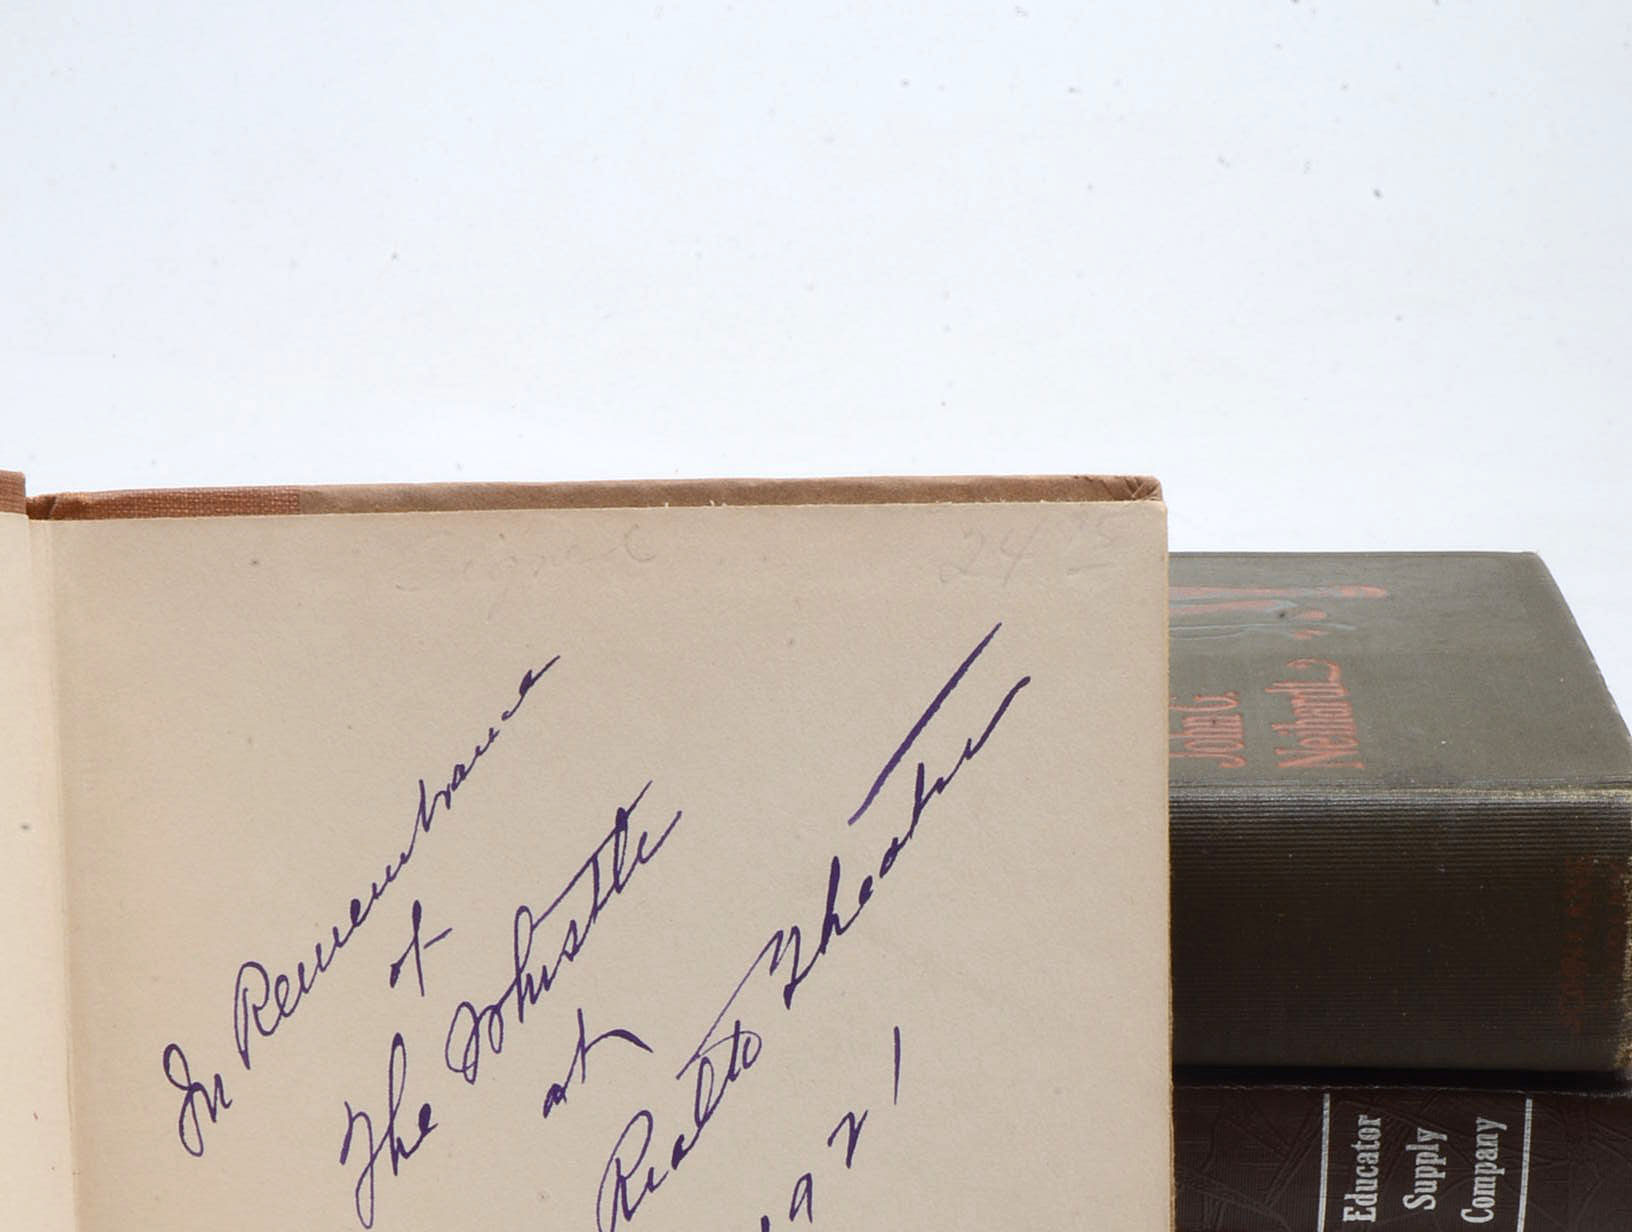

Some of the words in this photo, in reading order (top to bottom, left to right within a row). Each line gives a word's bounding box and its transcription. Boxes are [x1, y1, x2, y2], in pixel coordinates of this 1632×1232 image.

[390, 900, 452, 996] of
[163, 1044, 232, 1157] In
[543, 1008, 653, 1118] at
[340, 1032, 438, 1229] The
[1343, 1114, 1382, 1223] Educator
[1403, 1127, 1448, 1211] Supply
[1460, 1116, 1507, 1224] Company
